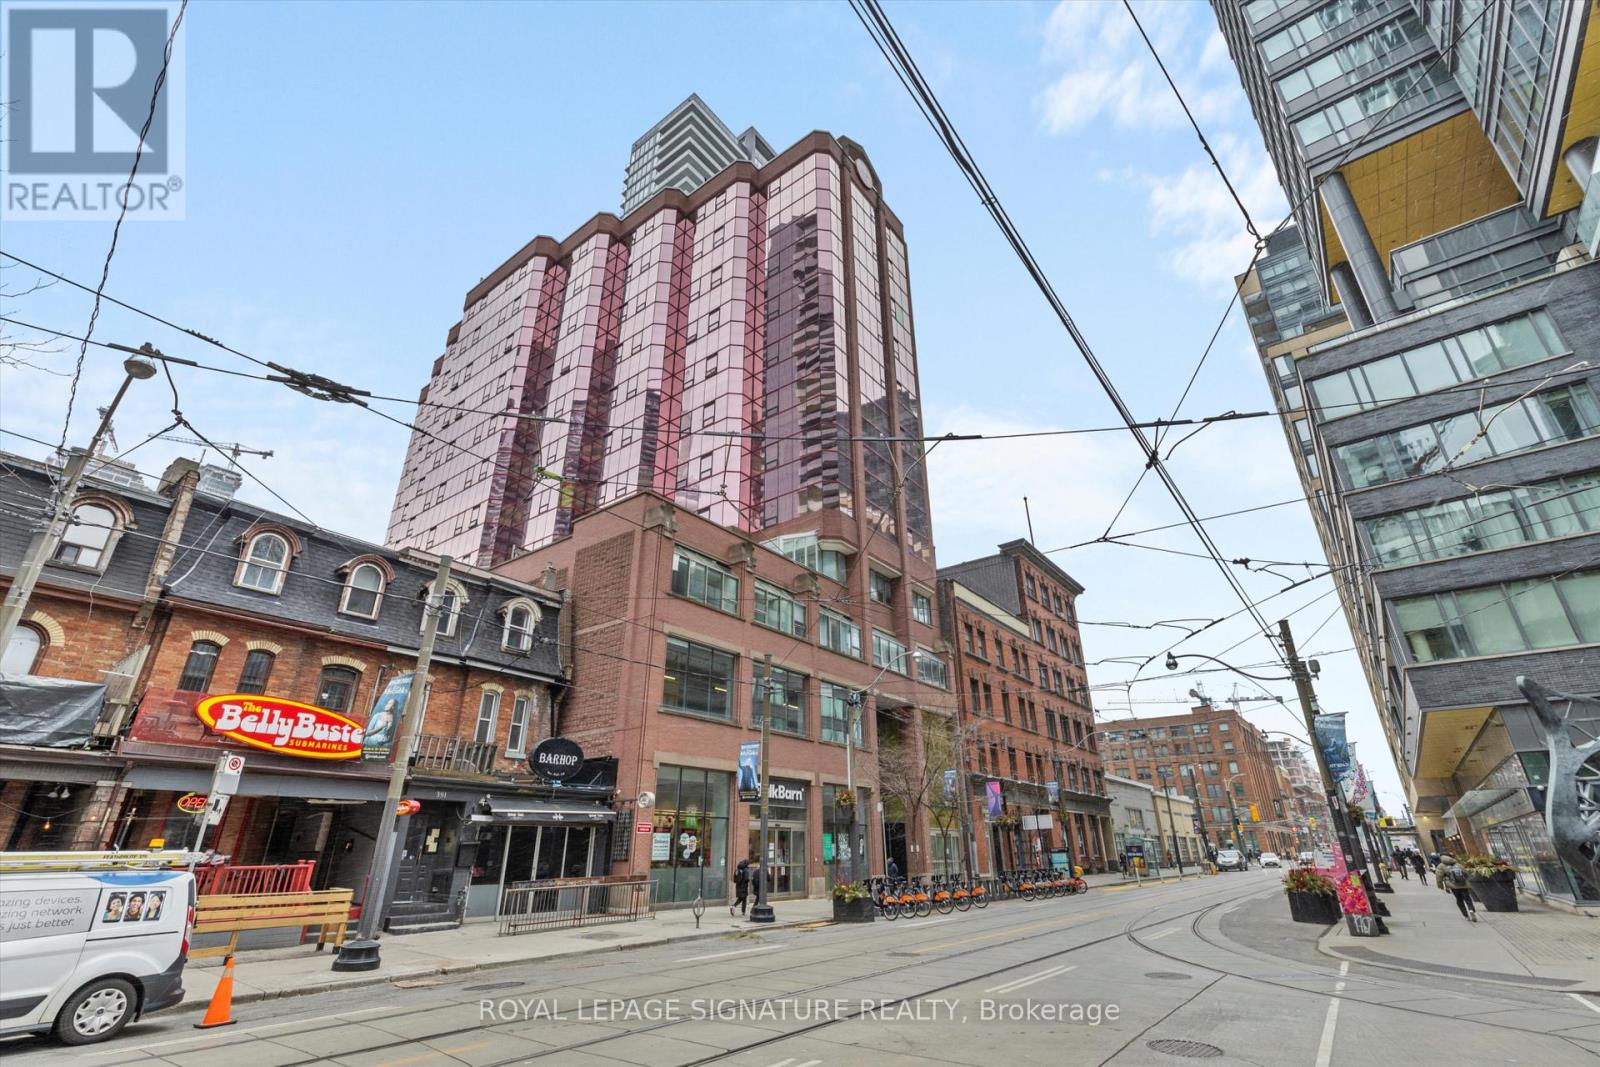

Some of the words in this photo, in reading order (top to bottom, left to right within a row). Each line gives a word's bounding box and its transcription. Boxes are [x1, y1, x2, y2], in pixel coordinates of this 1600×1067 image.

[242, 702, 262, 713] The
[288, 739, 348, 751] SUBMARINES
[539, 752, 578, 766] BARHOP
[35, 896, 82, 905] devices.
[31, 906, 84, 917] network.
[6, 921, 32, 933] just
[35, 918, 74, 929] better.
